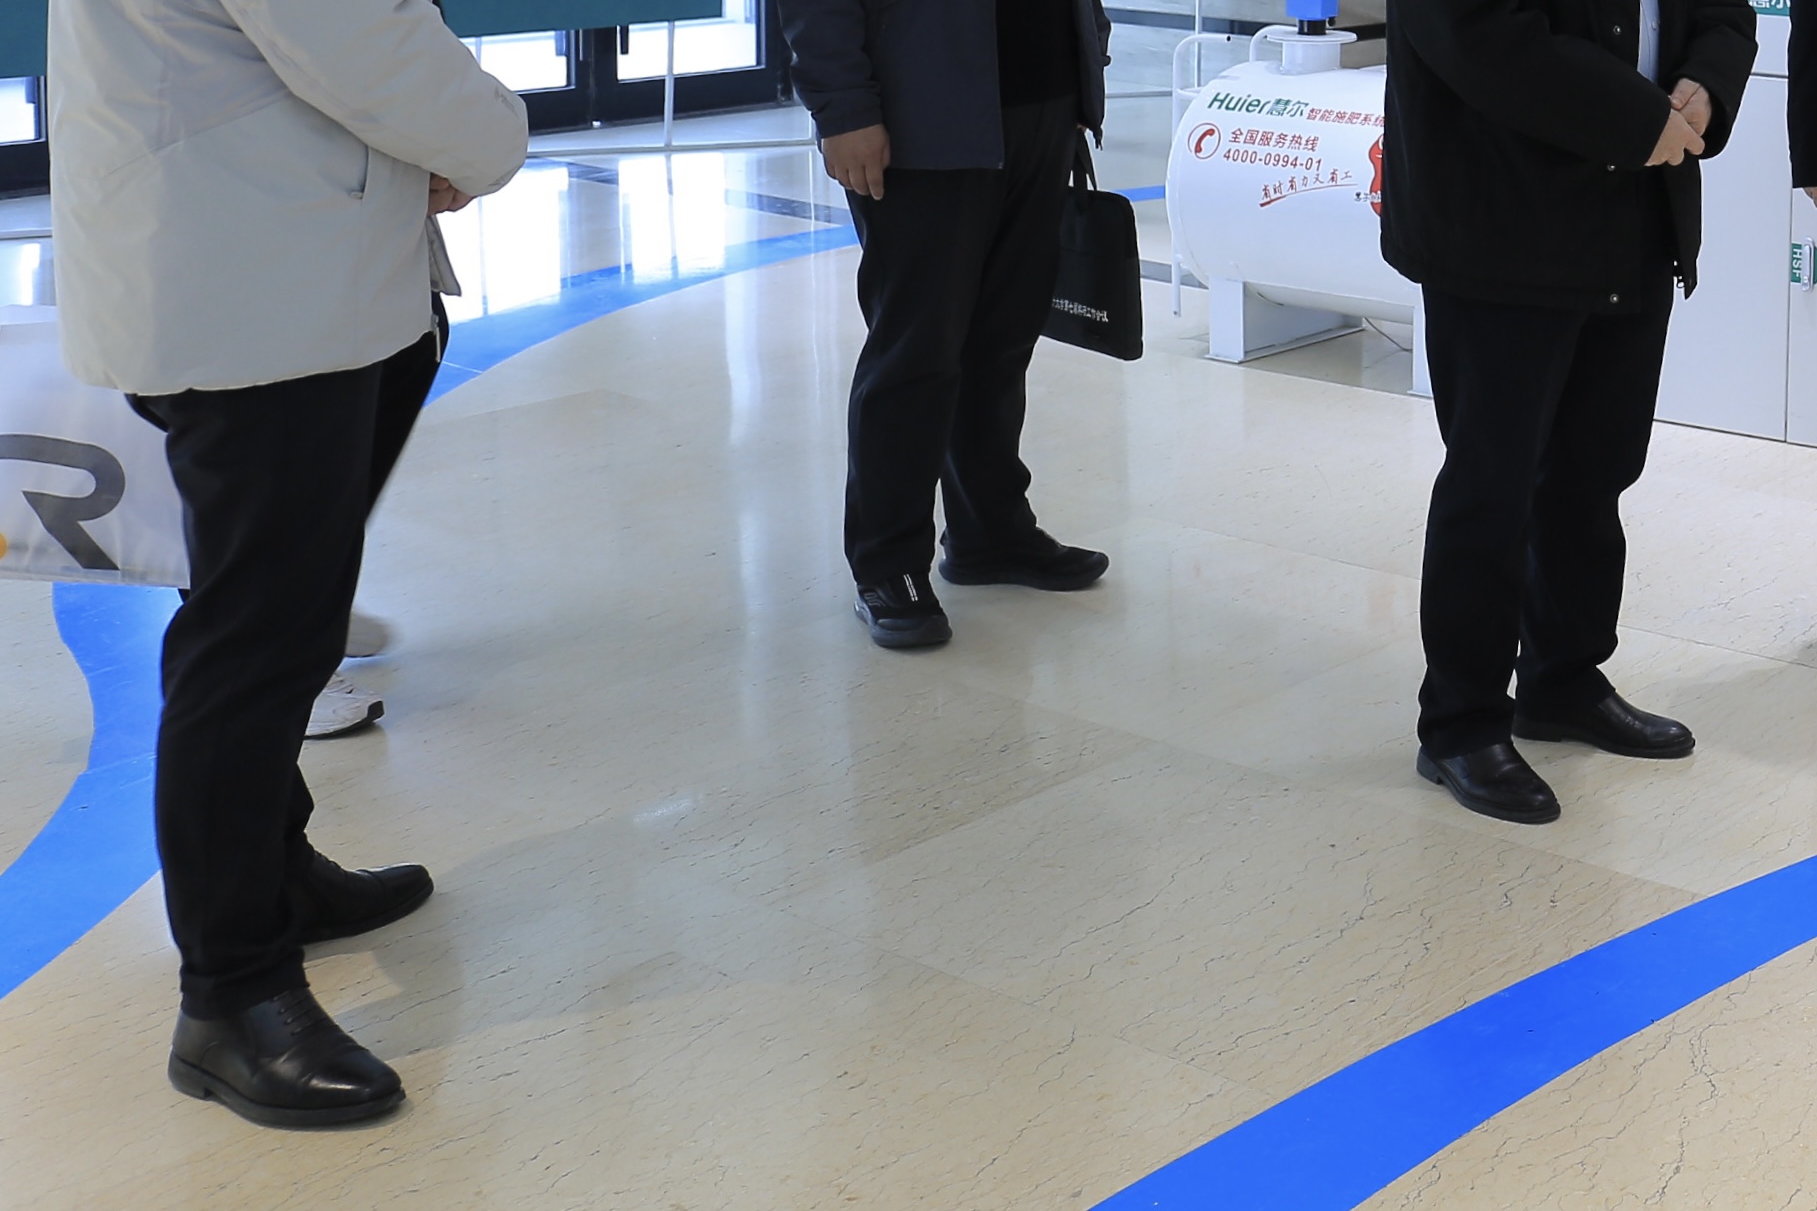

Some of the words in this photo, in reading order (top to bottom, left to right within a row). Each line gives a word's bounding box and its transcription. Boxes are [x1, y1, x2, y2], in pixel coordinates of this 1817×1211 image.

[1228, 127, 1319, 152] 全国服务热线
[1223, 148, 1322, 172] 4000-0994-01
